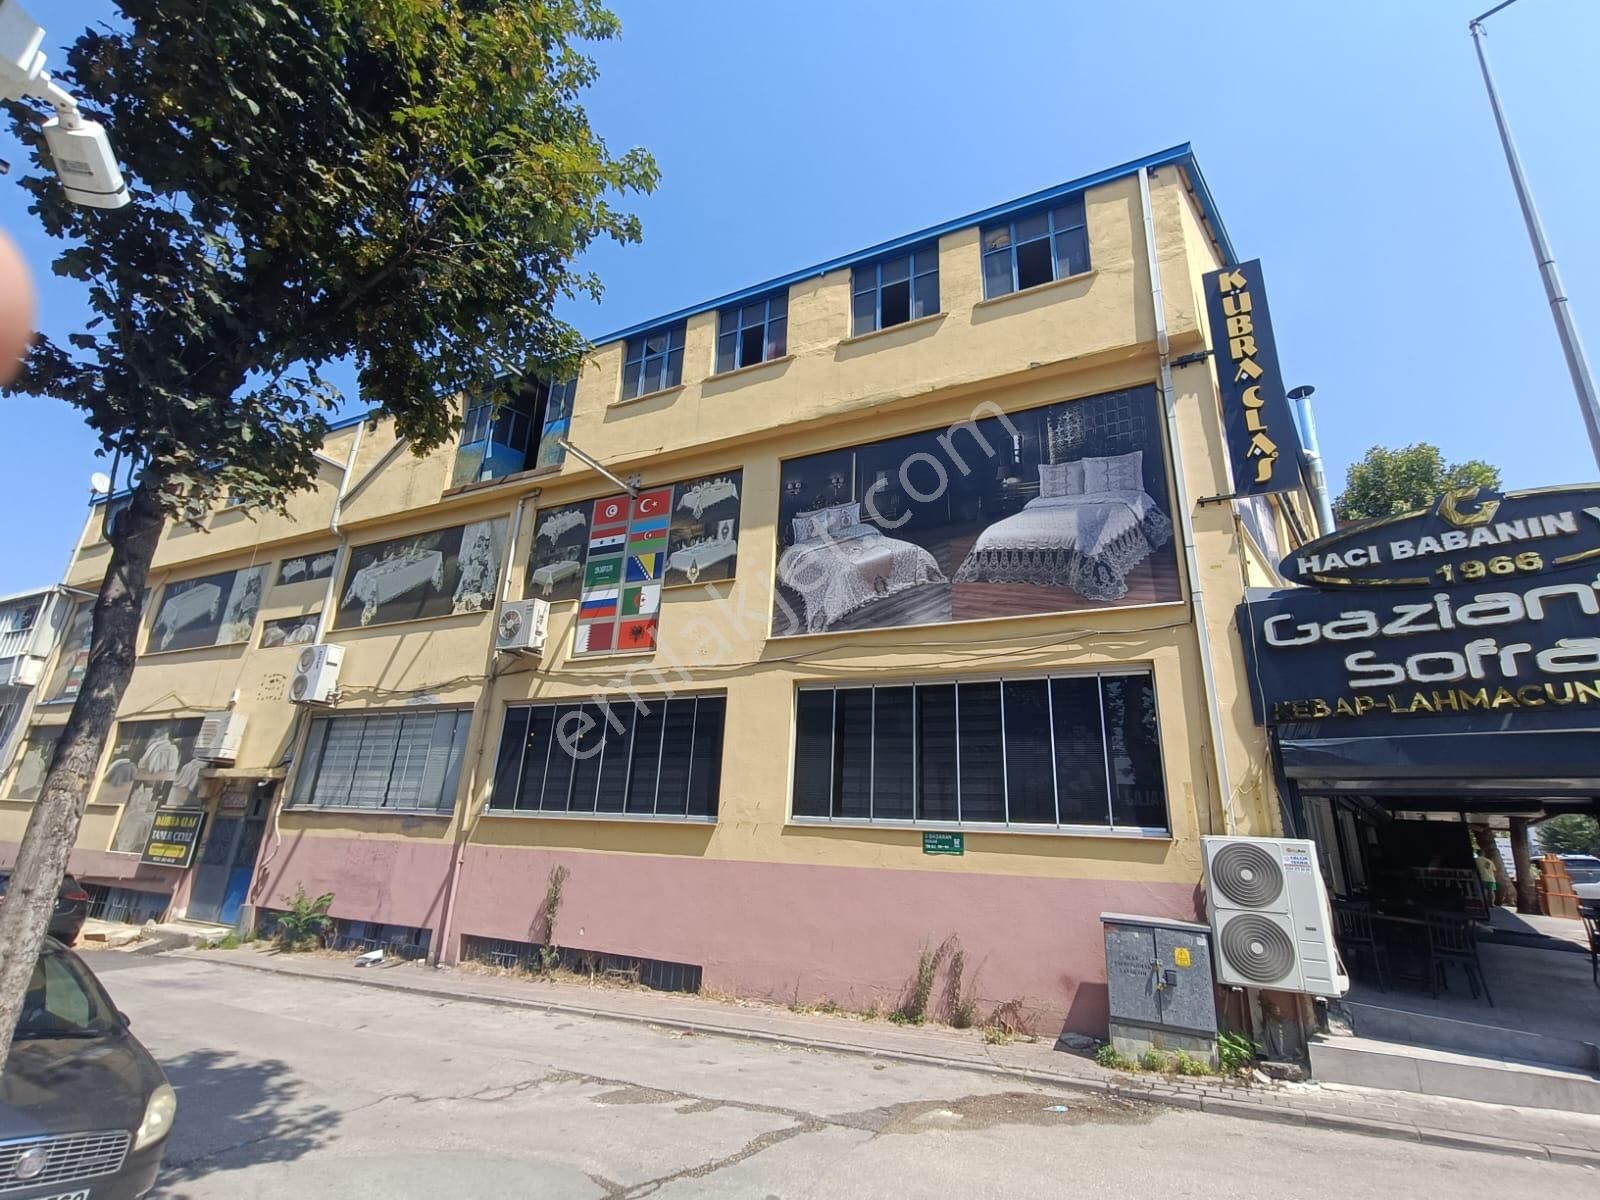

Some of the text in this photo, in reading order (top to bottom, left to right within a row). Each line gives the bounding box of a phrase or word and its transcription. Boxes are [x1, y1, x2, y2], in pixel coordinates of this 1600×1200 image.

[1297, 546, 1381, 575] HACI
[1390, 511, 1579, 561] BABANIN
[1435, 552, 1544, 584] 1966
[1264, 573, 1600, 647] Gazian
